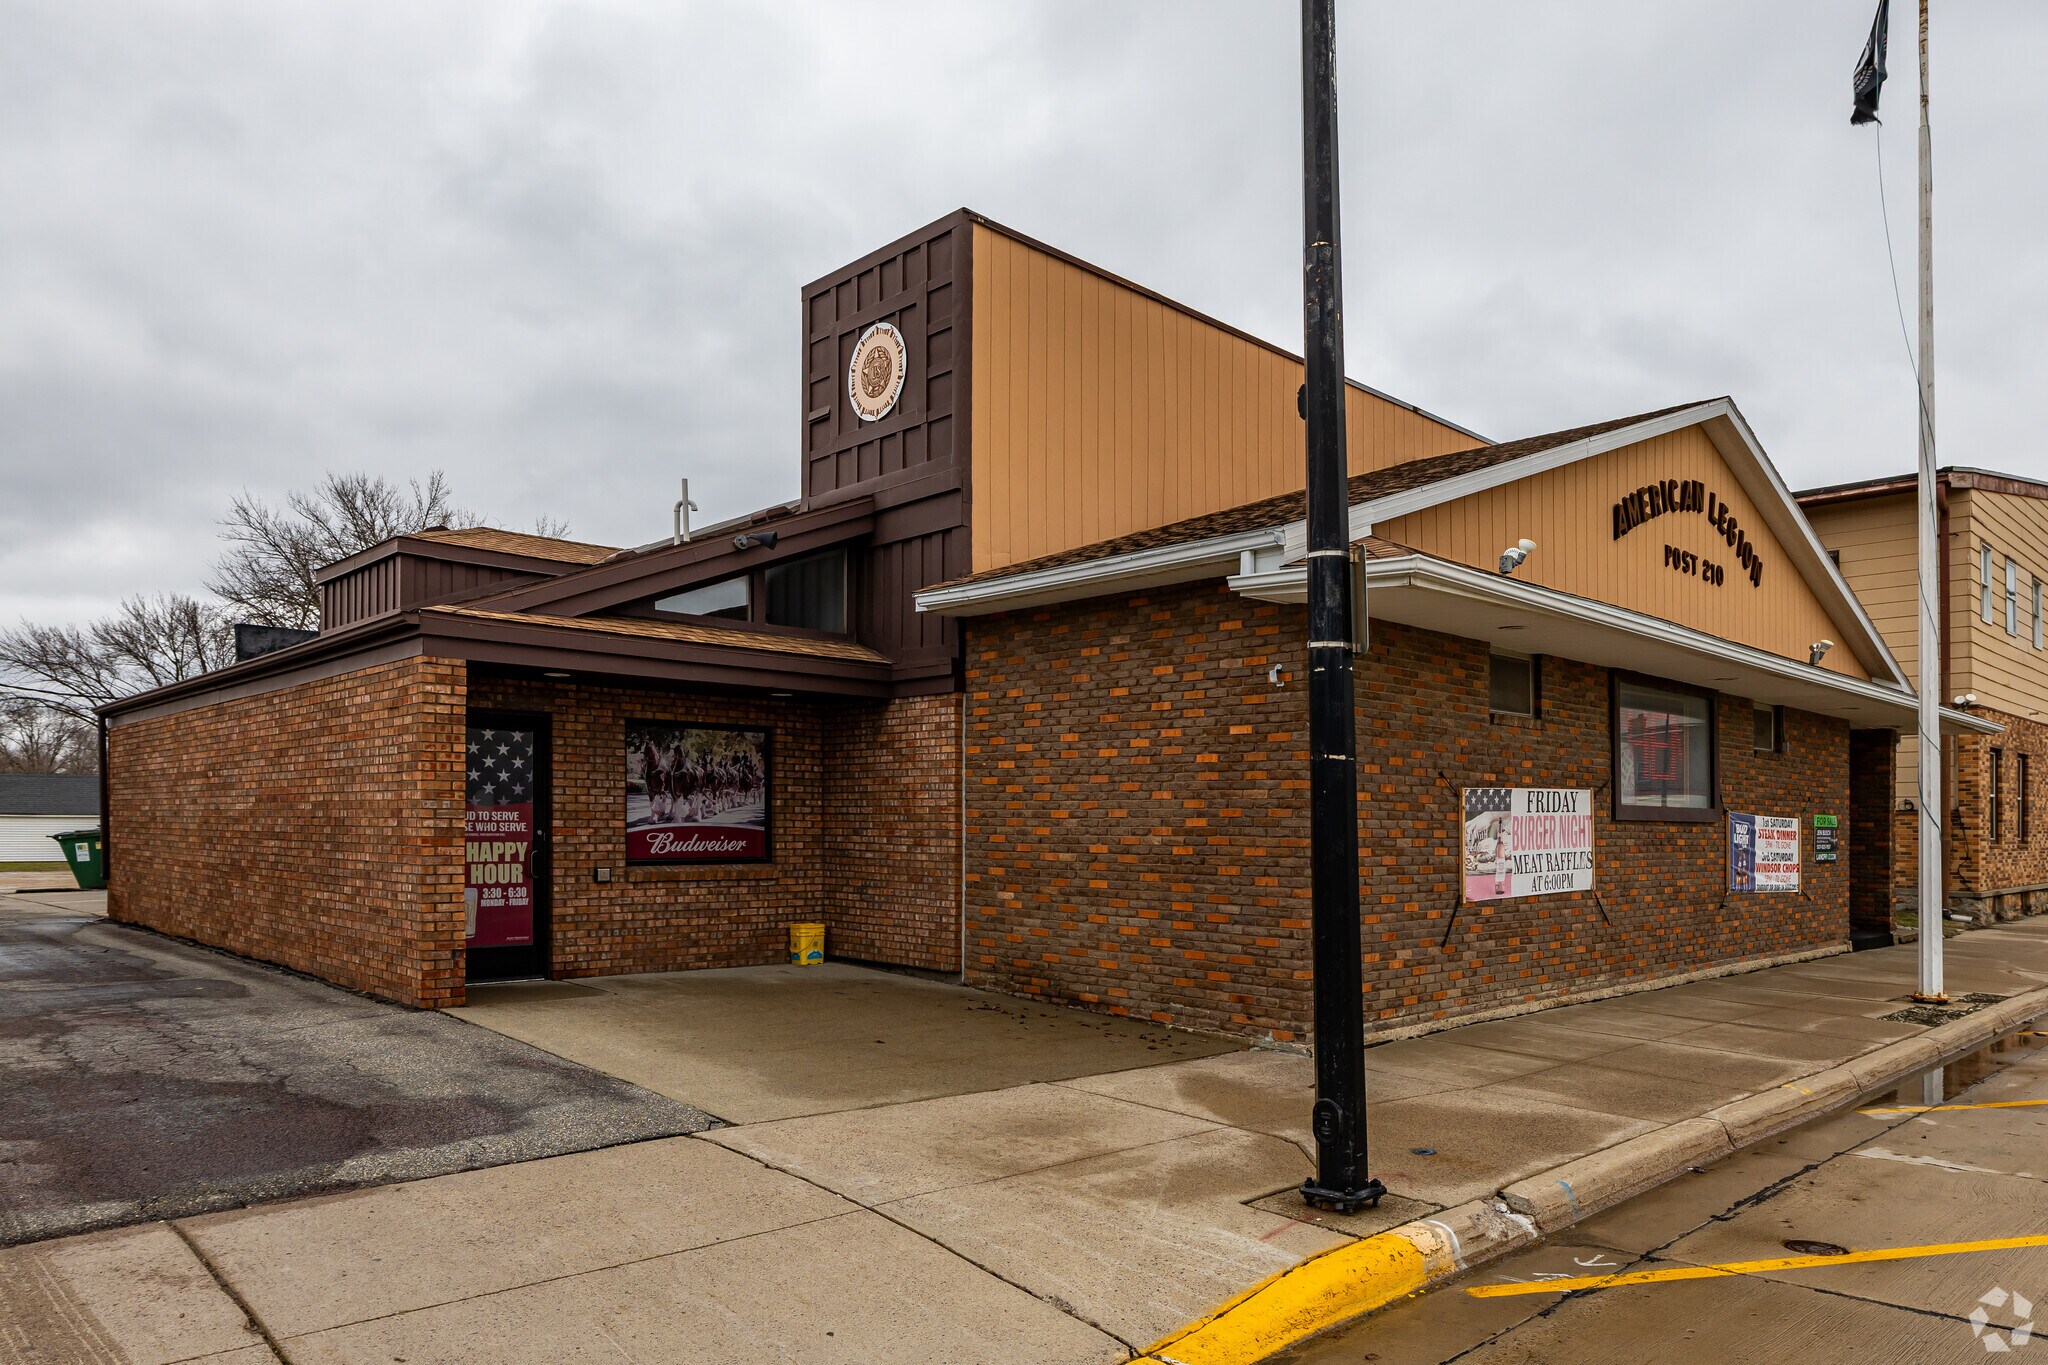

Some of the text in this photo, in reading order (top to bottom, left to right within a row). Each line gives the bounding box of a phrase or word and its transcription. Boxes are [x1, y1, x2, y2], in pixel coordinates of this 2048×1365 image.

[1613, 479, 1763, 588] AMERICAN LEGION
[1664, 544, 1724, 587] POST 210
[1526, 790, 1579, 813] FRIDAY
[478, 811, 489, 820] TO
[491, 811, 519, 820] SERVE
[1817, 817, 1837, 826] FOR SALE
[475, 822, 497, 832] WHO
[1735, 823, 1748, 834] BUD
[1770, 818, 1793, 828] SATURDAY
[1512, 814, 1592, 851] BURGER NIGHT
[1734, 833, 1749, 844] LIGHT
[1758, 829, 1797, 841] STEAK DINNER
[646, 832, 747, 854] Budweiser
[466, 841, 528, 862] HAPPY
[1762, 852, 1794, 862] 3rd SATURDAY
[1513, 851, 1593, 875] MEAT RAFFLES
[1756, 863, 1799, 873] WINDSOR CHOPS
[470, 863, 523, 885] HOUR
[1531, 873, 1574, 892] AT 6:00PM
[483, 887, 502, 899] 3:30
[508, 886, 527, 898] 6:30
[481, 899, 505, 907] MONDAY
[509, 898, 529, 906] FRIDAY
